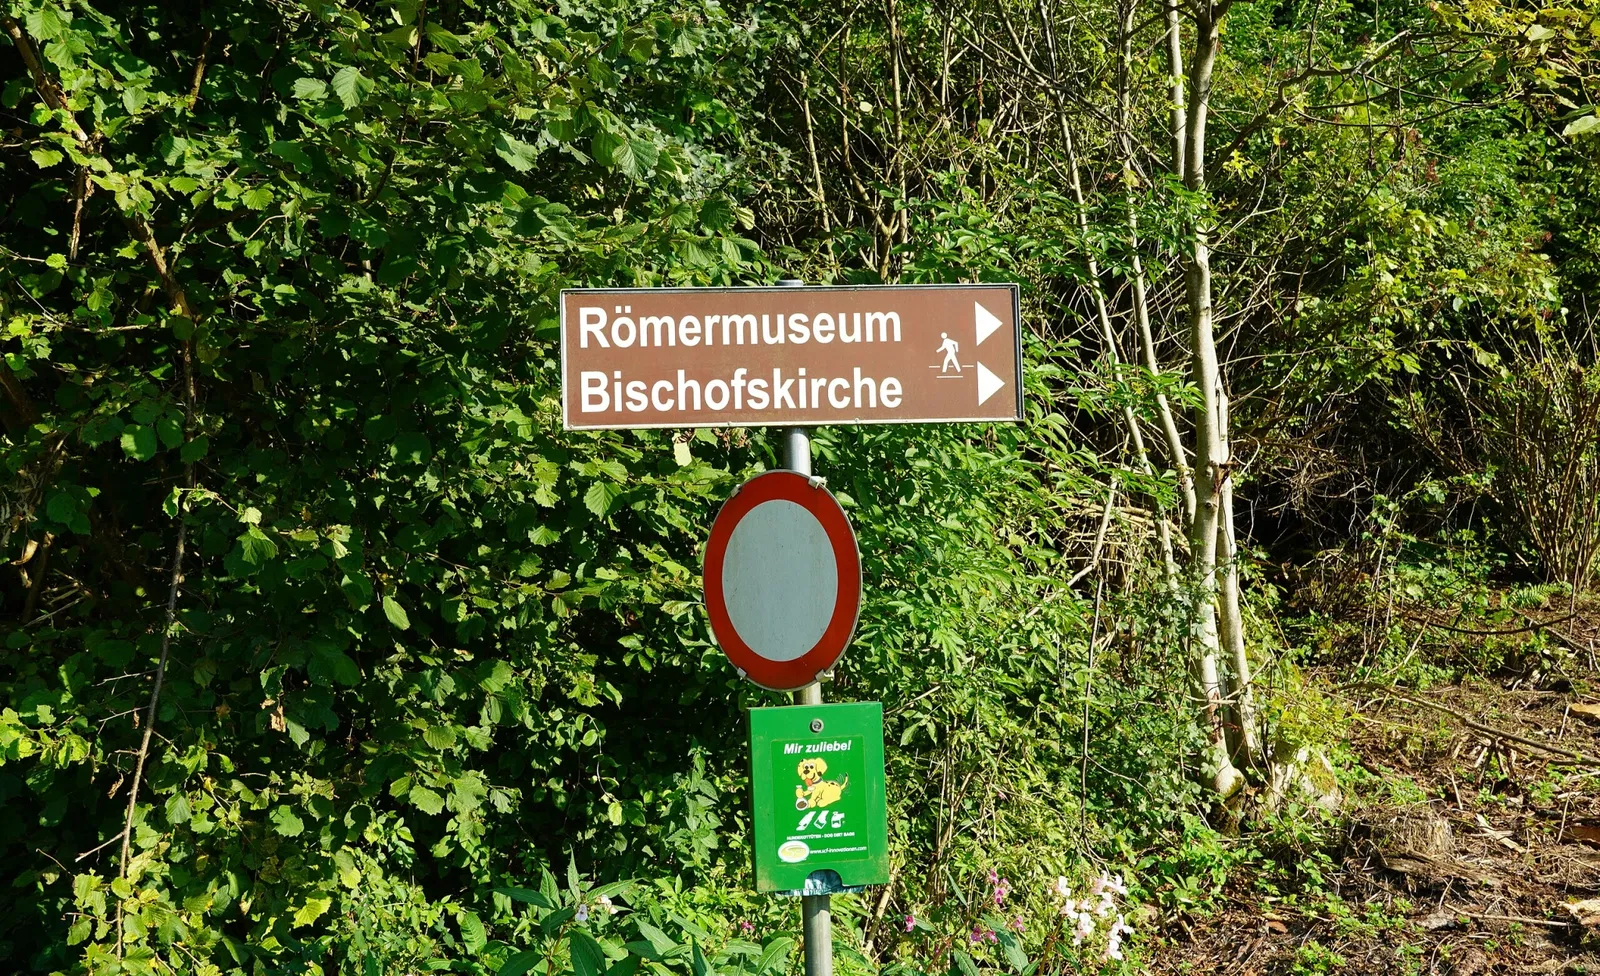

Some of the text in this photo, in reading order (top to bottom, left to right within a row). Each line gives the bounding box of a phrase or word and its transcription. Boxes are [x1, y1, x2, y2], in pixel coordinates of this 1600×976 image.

[579, 306, 902, 349] Römermuseum
[580, 367, 903, 412] Bischofskirche
[784, 740, 852, 754] Mir zuliebe!
